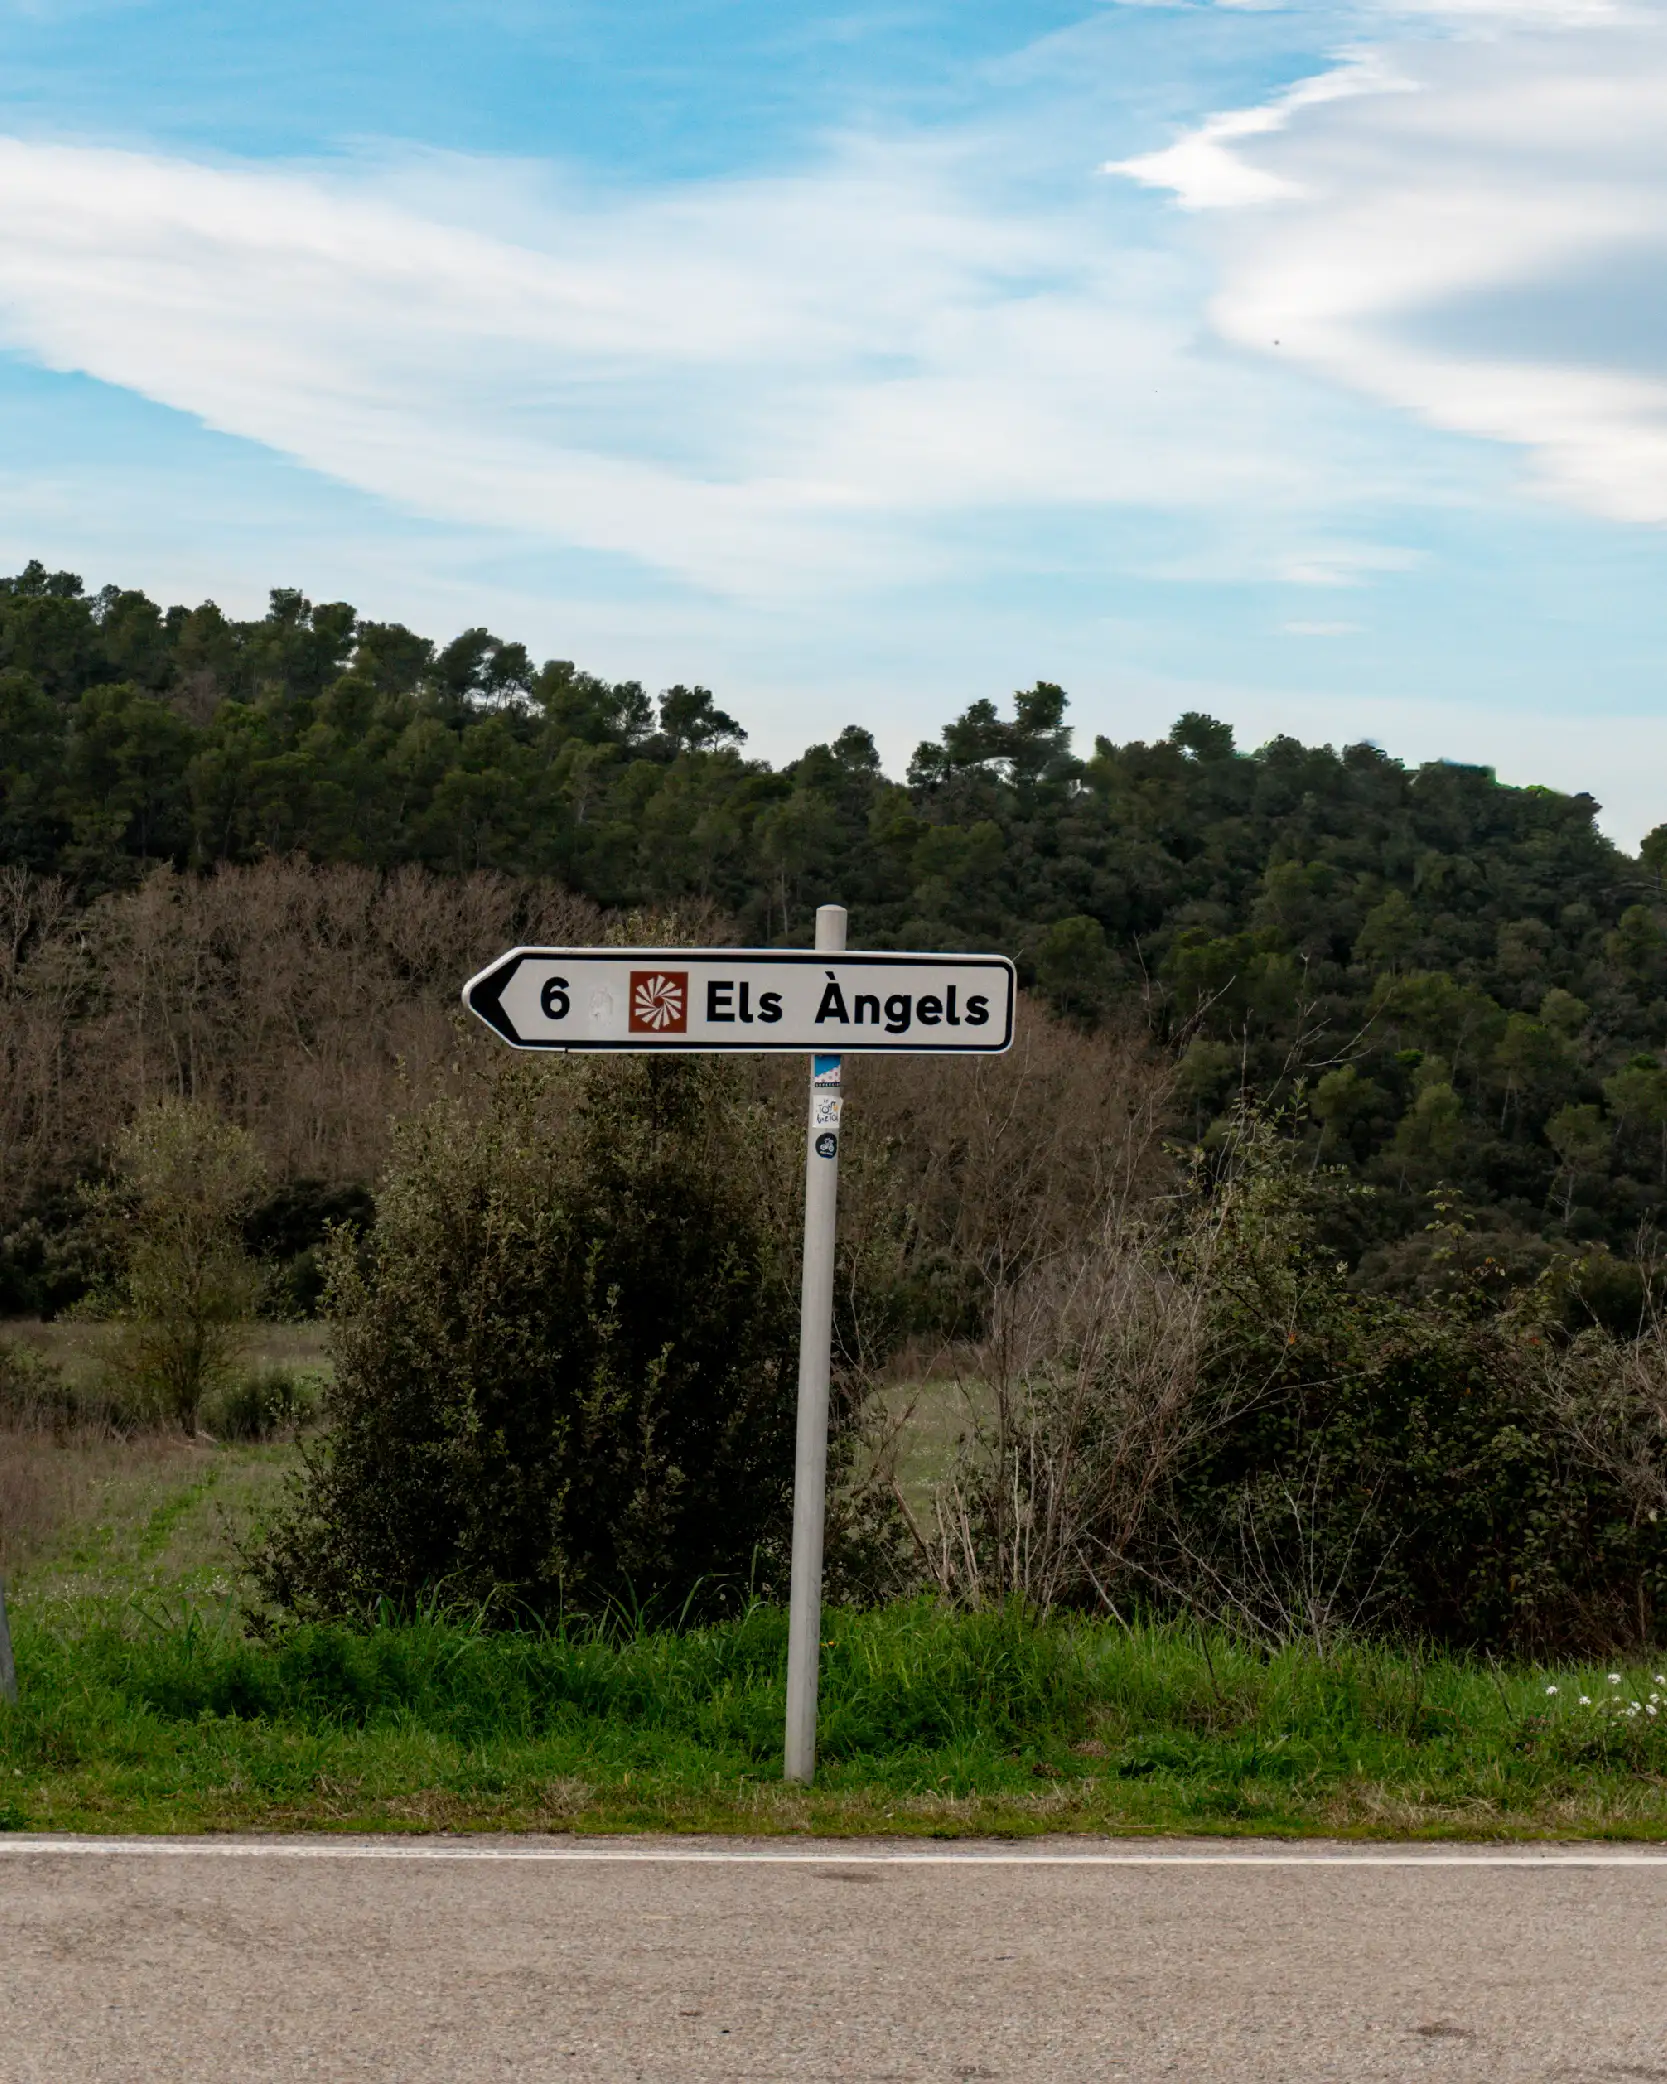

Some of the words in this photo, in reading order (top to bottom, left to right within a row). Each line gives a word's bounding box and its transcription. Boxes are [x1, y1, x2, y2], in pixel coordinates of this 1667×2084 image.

[540, 976, 571, 1021] 6
[706, 979, 783, 1024] Els
[814, 970, 990, 1034] Àngels
